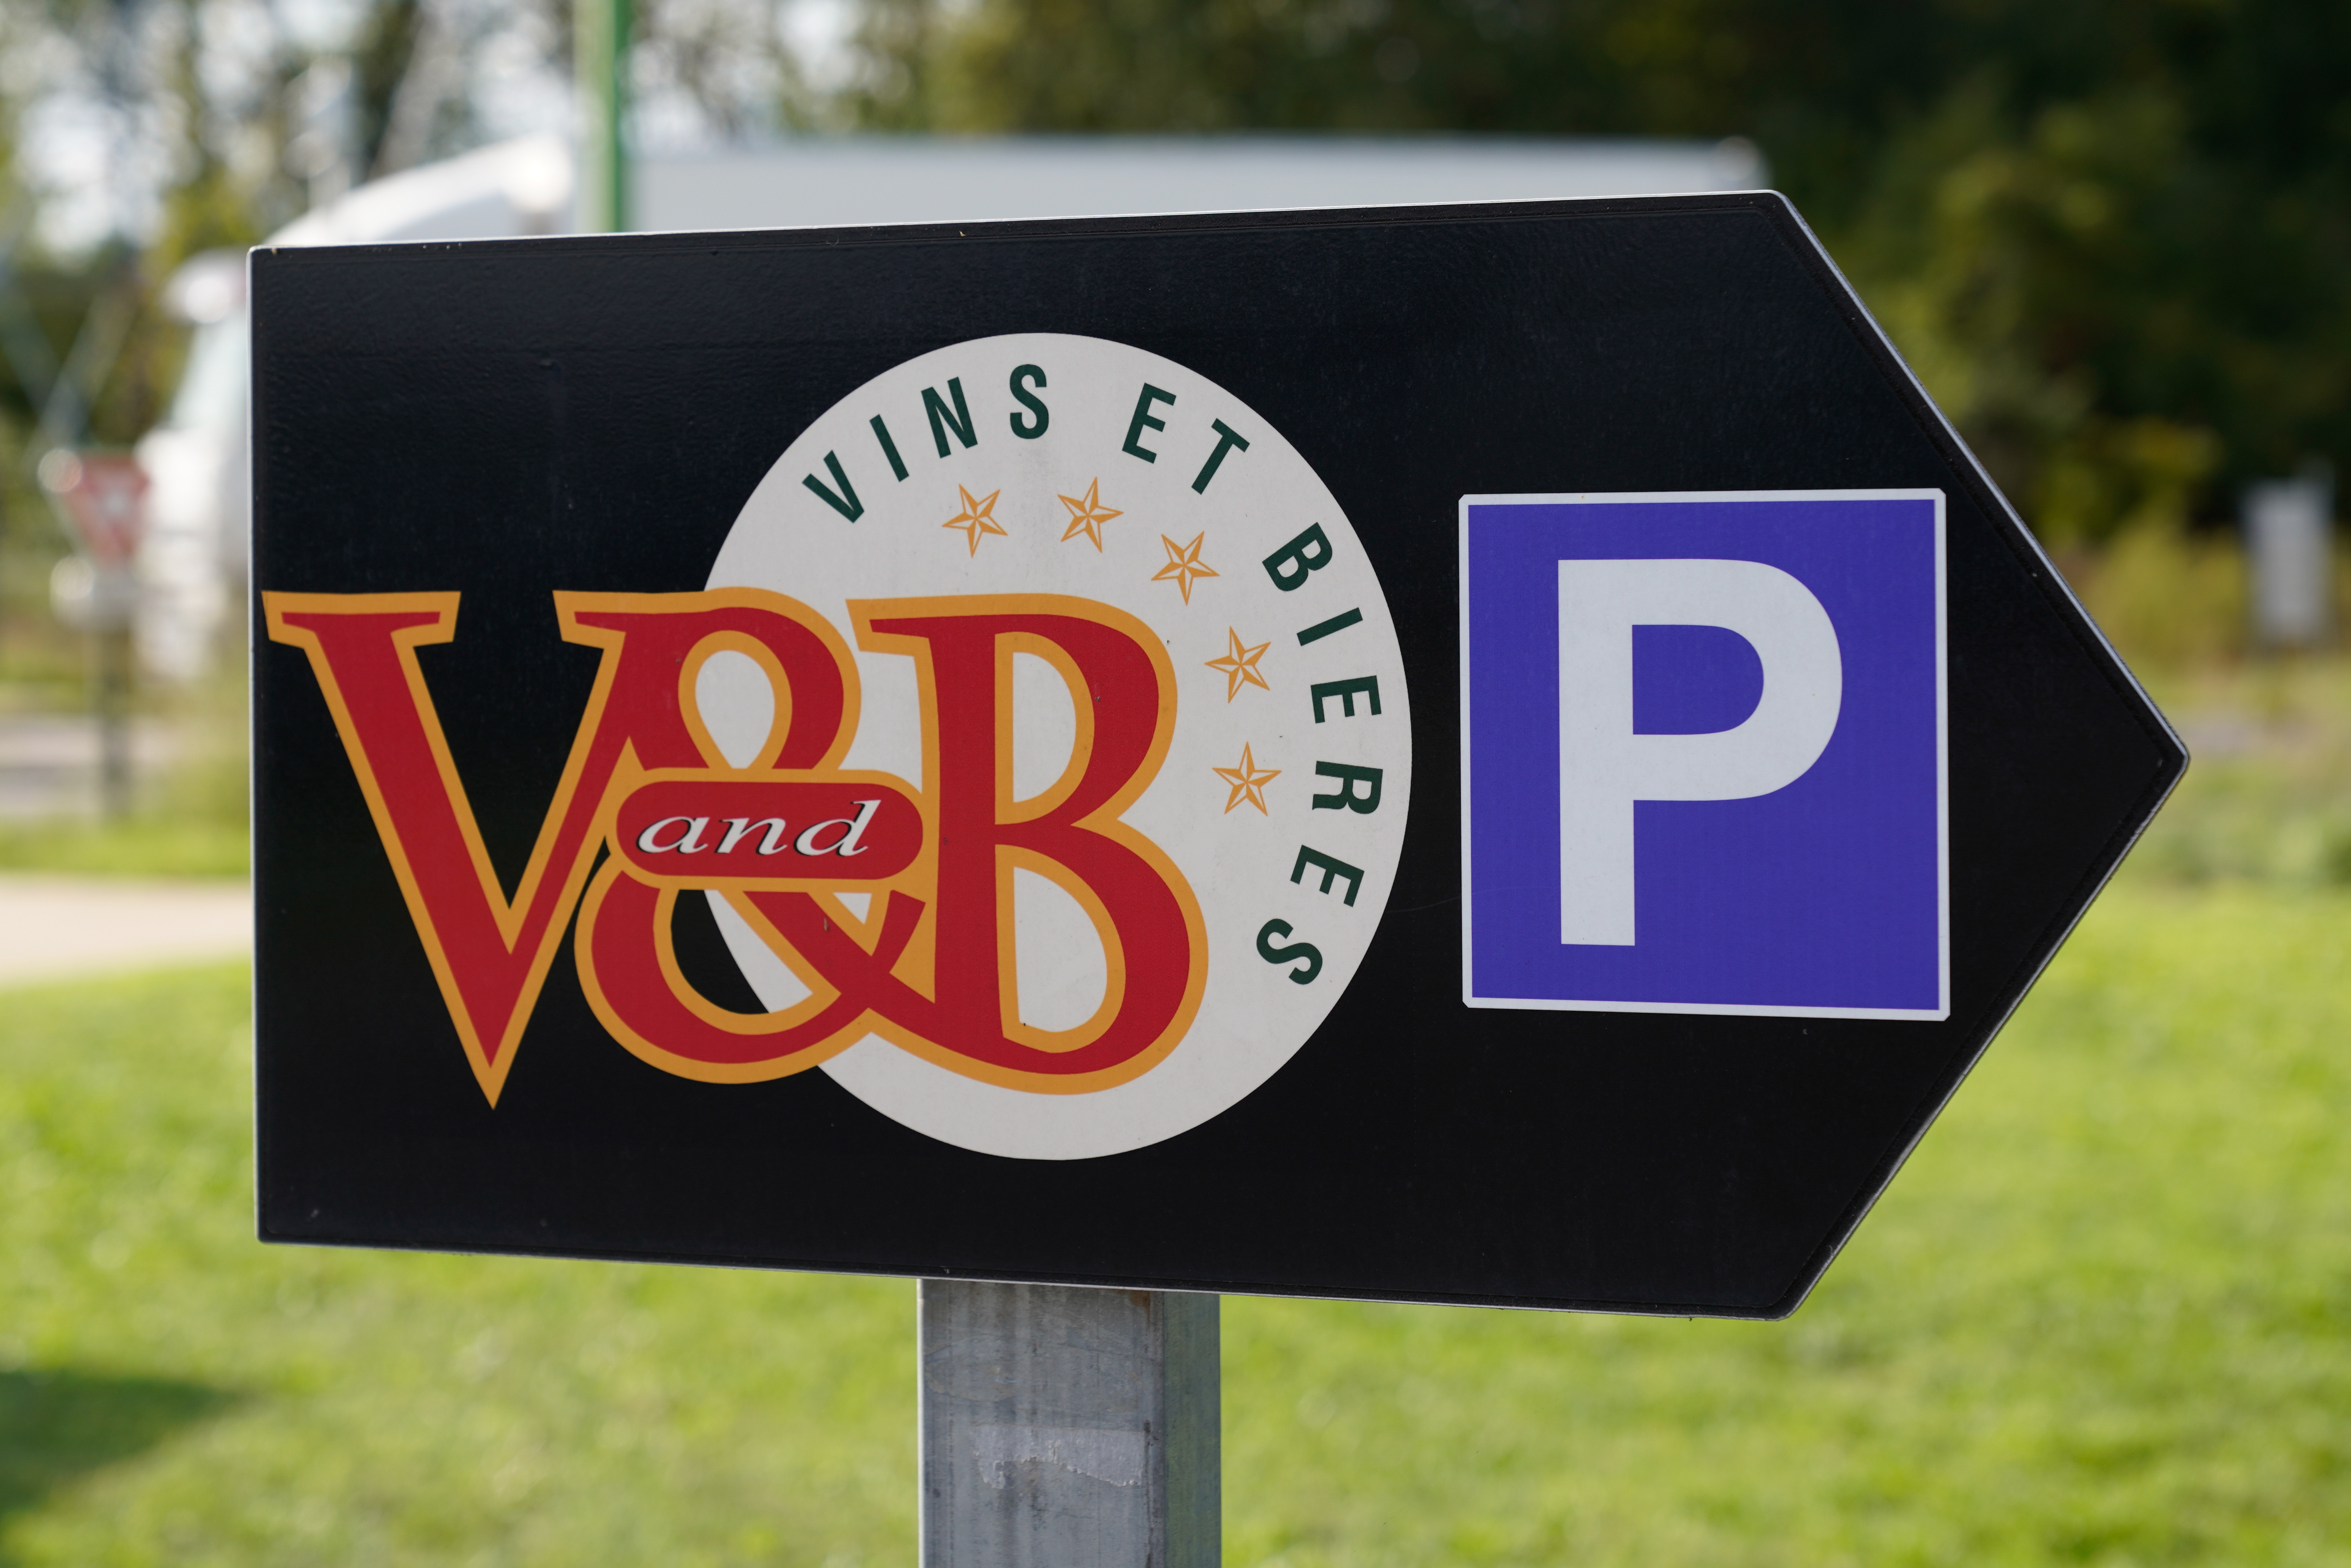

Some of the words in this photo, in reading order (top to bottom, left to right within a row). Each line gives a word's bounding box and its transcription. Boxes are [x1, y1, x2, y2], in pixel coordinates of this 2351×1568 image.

[262, 586, 1209, 1109] V&B
[637, 799, 882, 857] and
[801, 363, 1050, 524] VINS
[1121, 383, 1250, 496] ET
[1255, 522, 1383, 986] BIERES
[1558, 558, 1844, 948] P
